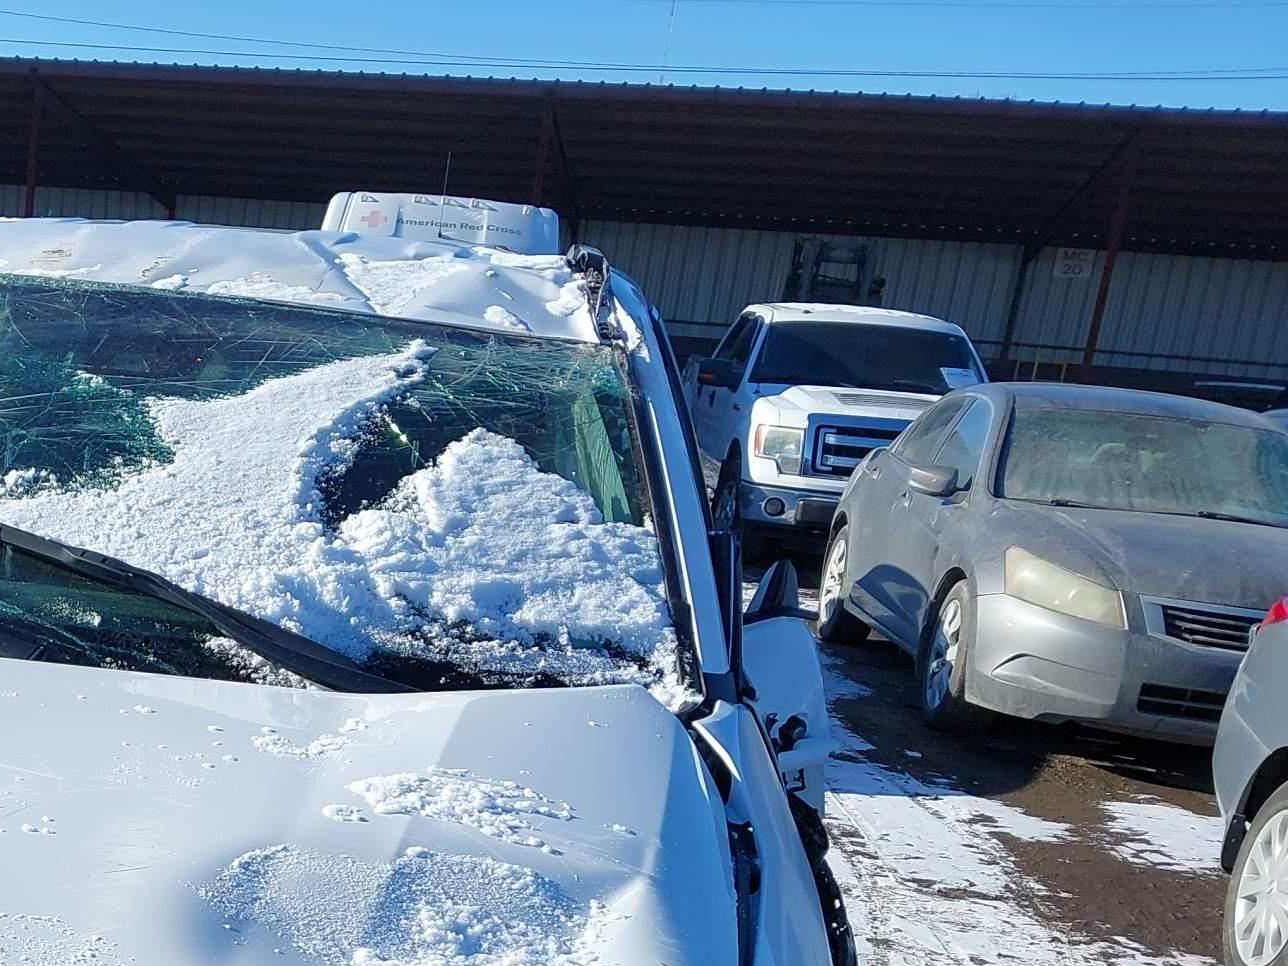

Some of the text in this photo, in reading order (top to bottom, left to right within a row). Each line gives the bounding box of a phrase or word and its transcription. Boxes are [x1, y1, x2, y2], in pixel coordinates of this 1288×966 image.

[397, 216, 522, 236] American Red Cross
